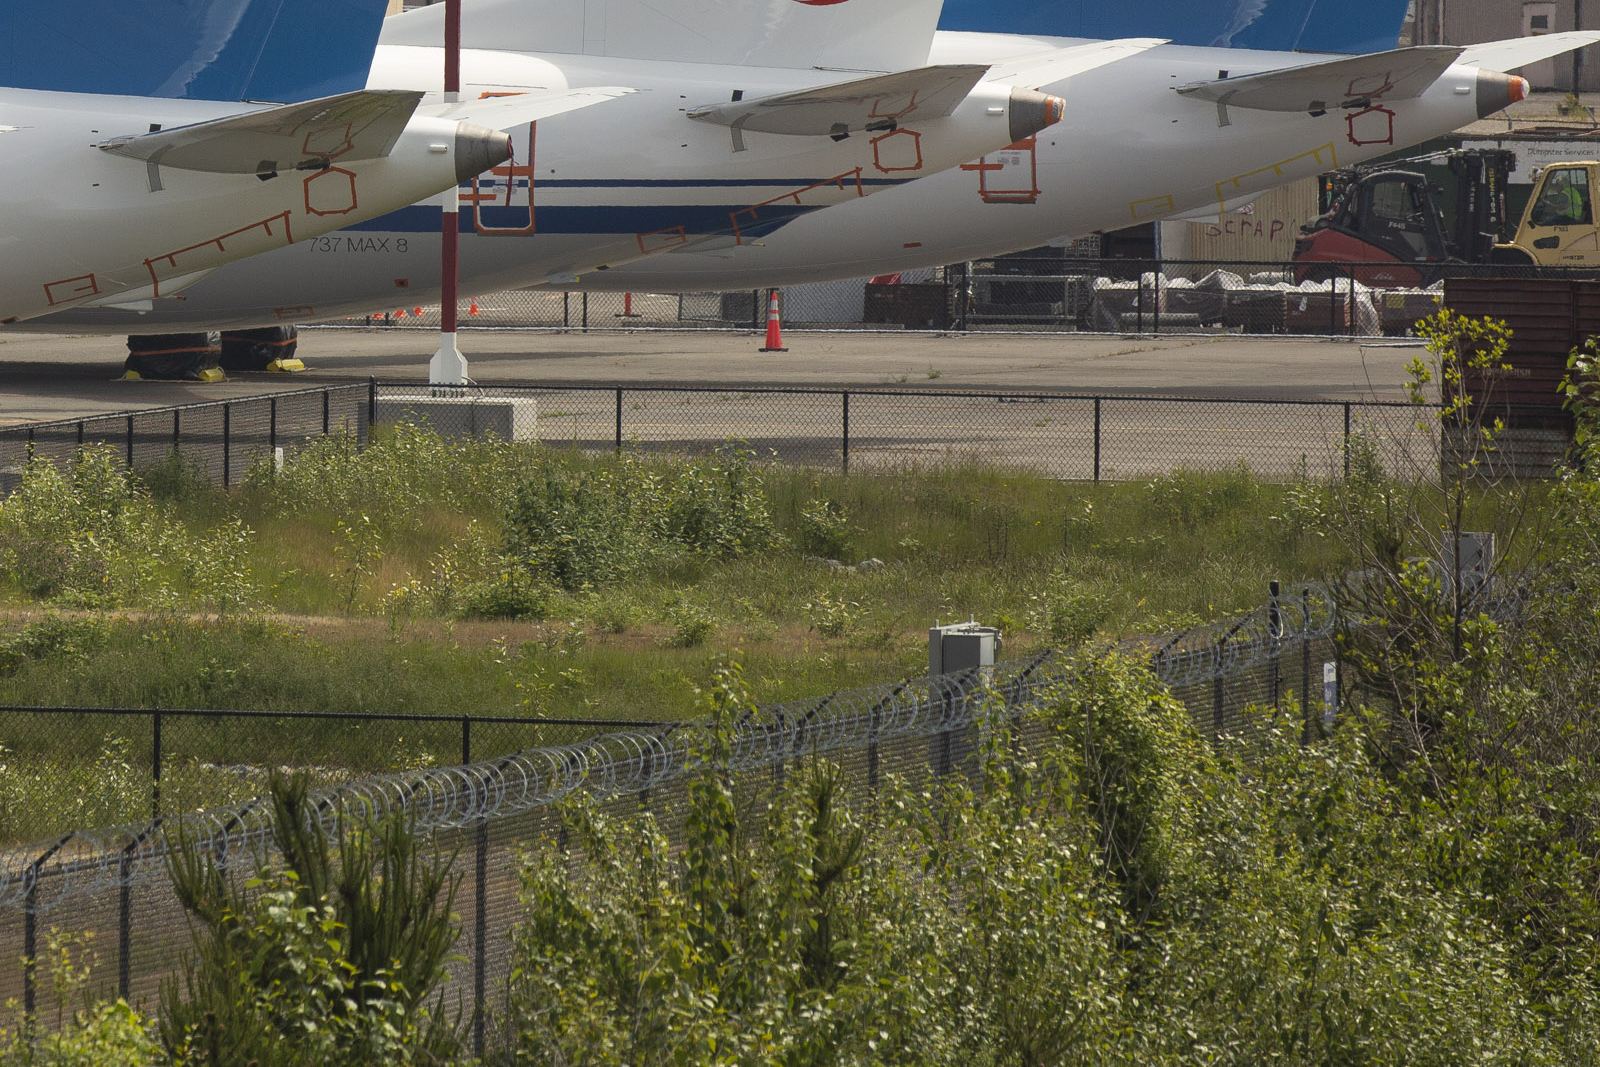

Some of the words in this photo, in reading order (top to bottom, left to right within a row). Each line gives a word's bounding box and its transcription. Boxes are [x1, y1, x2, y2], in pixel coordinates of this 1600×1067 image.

[1528, 148, 1562, 157] Dumpster
[1564, 148, 1594, 156] Services
[311, 237, 341, 252] 737
[348, 237, 389, 252] MAX
[396, 238, 408, 253] 8
